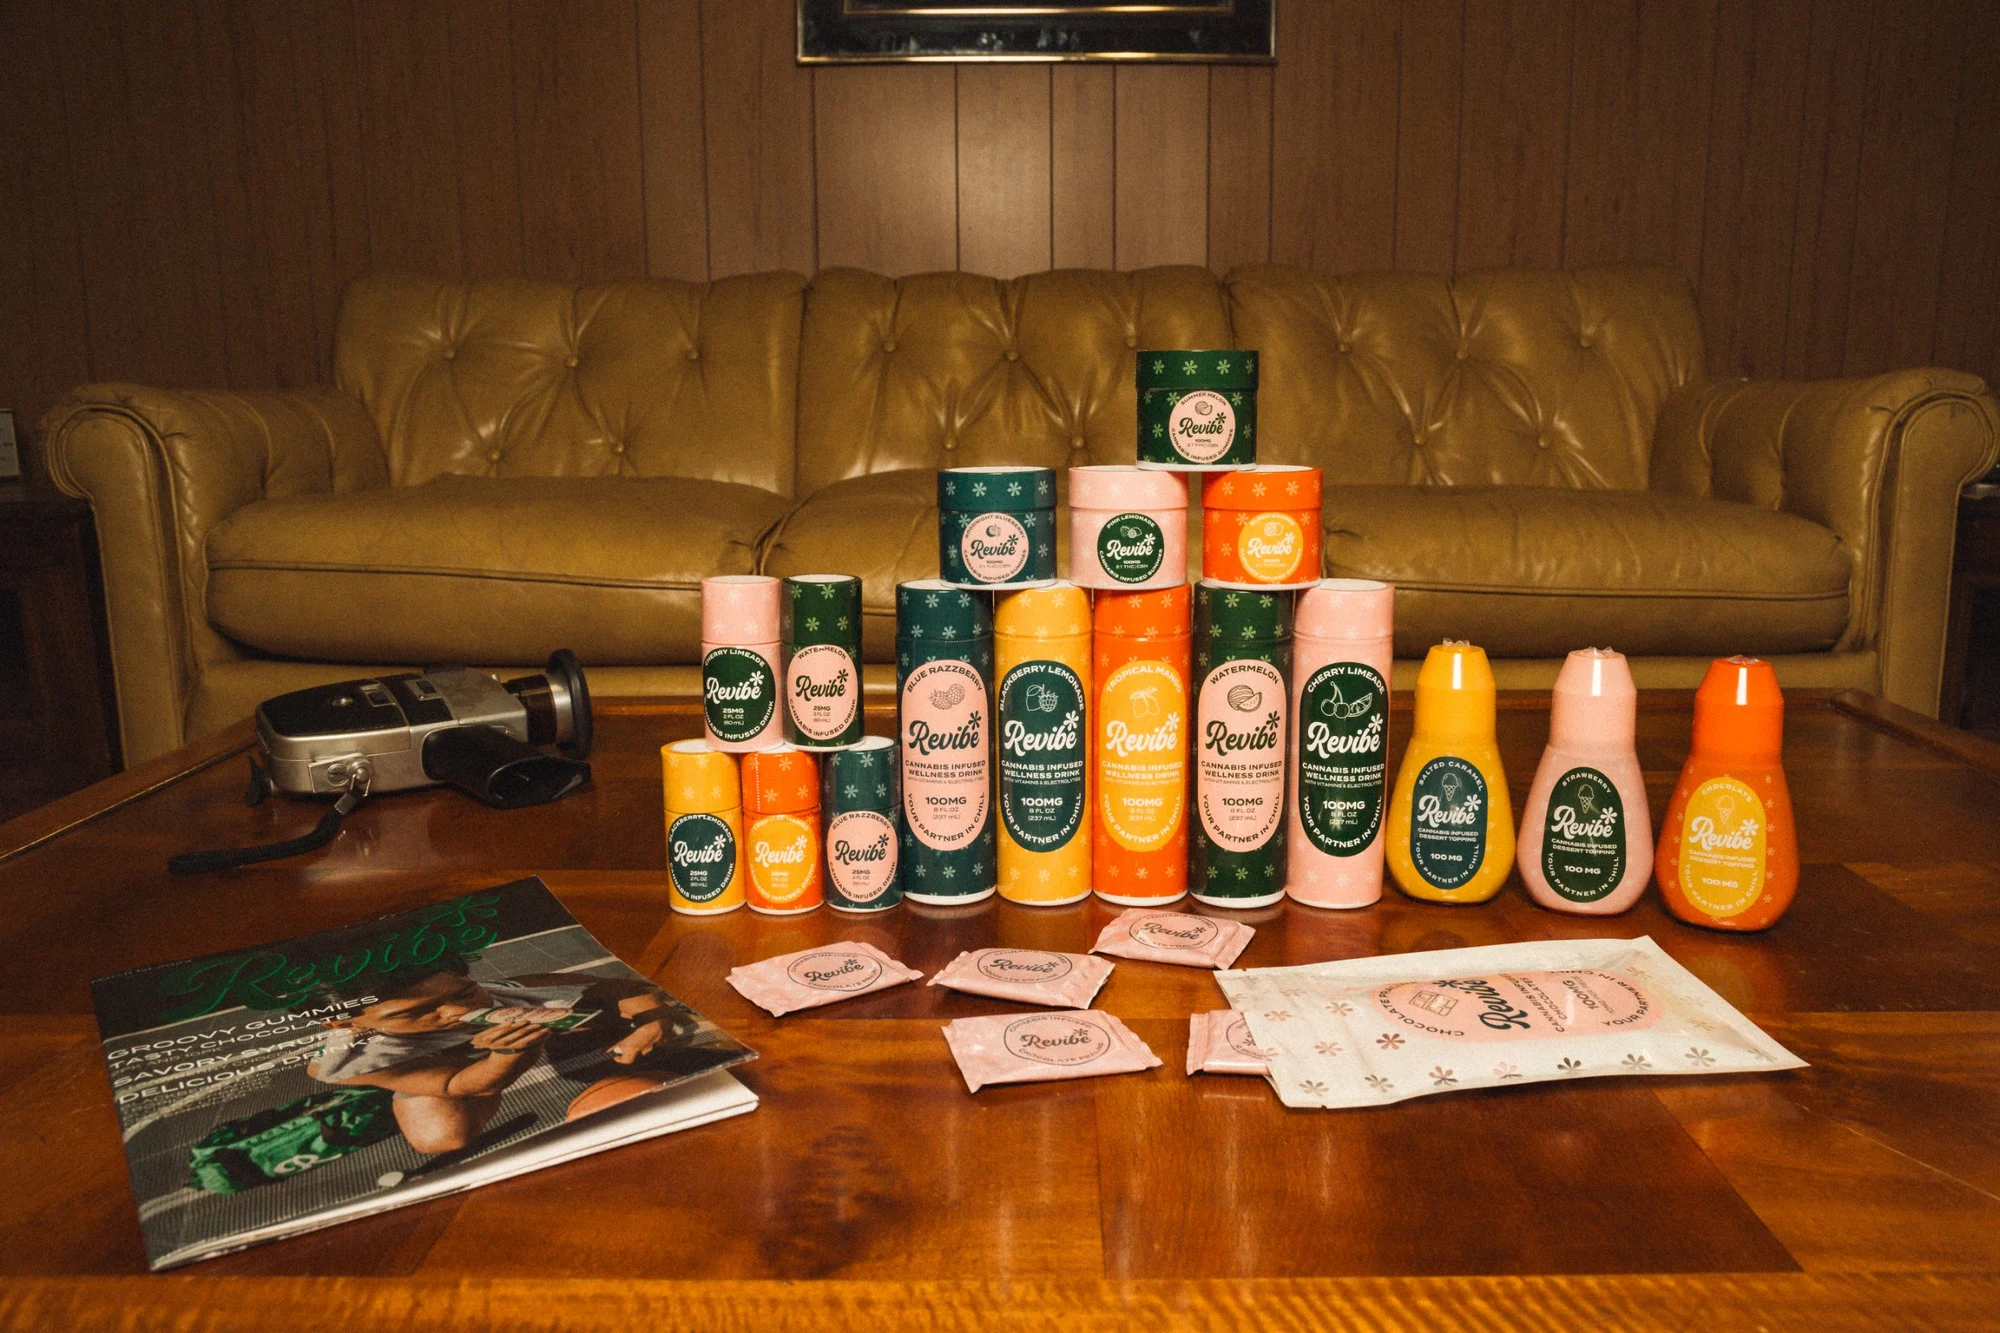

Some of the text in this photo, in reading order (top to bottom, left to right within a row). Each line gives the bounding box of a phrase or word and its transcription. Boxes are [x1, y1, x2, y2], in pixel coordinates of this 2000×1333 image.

[1207, 393, 1226, 406] MELON
[1179, 418, 1224, 438] Revibe
[1172, 428, 1190, 456] CANNABIS
[1106, 514, 1156, 528] PINK LEMONADE
[970, 540, 1016, 559] Revibe
[1106, 540, 1153, 560] Revibe
[1247, 538, 1293, 558] Revibe
[1120, 574, 1148, 582] INFUSED
[705, 650, 766, 667] CHERRY LIMEADE
[798, 646, 847, 660] WATERMELON
[908, 665, 982, 692] BLUE RAZZBERRY
[1107, 666, 1181, 692] TROPICAL MANGO
[1210, 665, 1279, 684] WATERMELON
[1308, 667, 1385, 694] CHERRY LIMEADE
[706, 677, 762, 704] Revibe
[796, 675, 846, 702] Revibe
[1000, 665, 1084, 711] BLACKBERRY LEMONADE
[724, 726, 760, 740] INFUSED
[760, 700, 774, 725] DRINK
[790, 699, 856, 736] CANNABIS INFUSED DRINK
[909, 720, 980, 756] Revibe
[1004, 720, 1077, 756] Revibe
[1106, 720, 1178, 757] Revibe
[1206, 720, 1277, 756] Revibe
[1307, 721, 1380, 758] Revibe
[906, 760, 986, 770] CANNABIS INFUSED
[909, 768, 982, 778] WELLNESS DRINK
[1002, 760, 1083, 770] CANNABIS INFUSED
[1004, 769, 1080, 778] WELLNESS DRINK
[1102, 760, 1182, 771] CANNABIS INFUSED
[1105, 770, 1180, 780] WELLNESS DRINK
[1201, 760, 1282, 770] CANNABIS INFUSED
[1205, 770, 1279, 778] WELLNESS DRINK
[1302, 762, 1384, 774] CANNABIS INFUSED
[1306, 772, 1382, 782] WELLNESS DRINK
[1418, 761, 1484, 791] SALTED CARAMEL
[1562, 772, 1612, 794] STRAWBERRY
[1702, 784, 1752, 803] CHOCOLATE
[926, 796, 966, 805] 100MG
[1021, 798, 1063, 806] 100MG
[1122, 798, 1163, 806] 100MG
[1222, 798, 1264, 806] 100MG
[1322, 800, 1366, 810] 100MG
[1417, 795, 1476, 828] Revibe
[832, 813, 890, 830] BLUE RAZZBERRY
[908, 793, 919, 822] YOUR
[918, 824, 964, 841] PARTNER
[966, 824, 974, 834] IN
[974, 792, 984, 823] CHILL
[1004, 793, 1014, 824] YOUR
[1013, 824, 1059, 844] PARTNER
[1060, 824, 1070, 836] IN
[1070, 792, 1081, 824] CHILL
[1204, 794, 1215, 824] YOUR
[1213, 824, 1258, 843] PARTNER
[1260, 824, 1269, 836] IN
[1269, 792, 1280, 824] CHILL
[1304, 796, 1315, 827] YOUR
[1313, 828, 1360, 848] PARTNER
[1362, 828, 1371, 840] IN
[1370, 796, 1382, 828] CHILL
[1551, 805, 1613, 840] Revibe
[668, 815, 734, 843] BLACKBERRY LEMONADE
[1114, 824, 1158, 842] PARTNER
[1161, 826, 1170, 836] IN
[1418, 828, 1449, 836] CANNABIS
[1688, 816, 1753, 851] Revibe
[674, 840, 724, 867] Revibe
[755, 841, 804, 868] Revibe
[834, 840, 887, 866] Revibe
[1552, 838, 1618, 850] CANNABIS INFUSED
[1553, 844, 1584, 854] DESSERT
[1416, 842, 1480, 884] YOUR PARTNER IN CHILL
[1430, 853, 1462, 862] 100 MG
[1564, 865, 1583, 874] 100
[691, 888, 720, 900] INFUSED
[720, 862, 734, 888] DRINK
[853, 886, 882, 899] INFUSED
[882, 862, 895, 886] DRINK
[1548, 853, 1619, 896] YOUR PARTNER IN CHILL
[1702, 877, 1738, 888] 100 MG
[1692, 890, 1733, 910] PARTNER
[1736, 898, 1746, 906] IN
[1141, 922, 1200, 940] Revibe
[804, 964, 864, 982] Revibe
[990, 958, 1053, 973] Revibe
[1460, 980, 1530, 1030] Revibe
[1520, 976, 1568, 1020] CHOCOLATES
[1562, 980, 1599, 1010] 100MG
[1599, 973, 1649, 1026] YOUR PARTNER IN
[1380, 998, 1464, 1036] CHOCOLATE
[1526, 995, 1564, 1032] CANNABIS
[108, 996, 379, 1060] GROOVY GUMMIES
[109, 1046, 192, 1069] TASTY
[200, 1012, 352, 1050] CHOCOLATE
[1020, 1034, 1092, 1050] Revibe
[113, 1053, 233, 1088] SAVORY
[241, 1028, 353, 1059] SYRUPS
[119, 1061, 276, 1105] DELICIOUS
[282, 1034, 387, 1066] DRINKS
